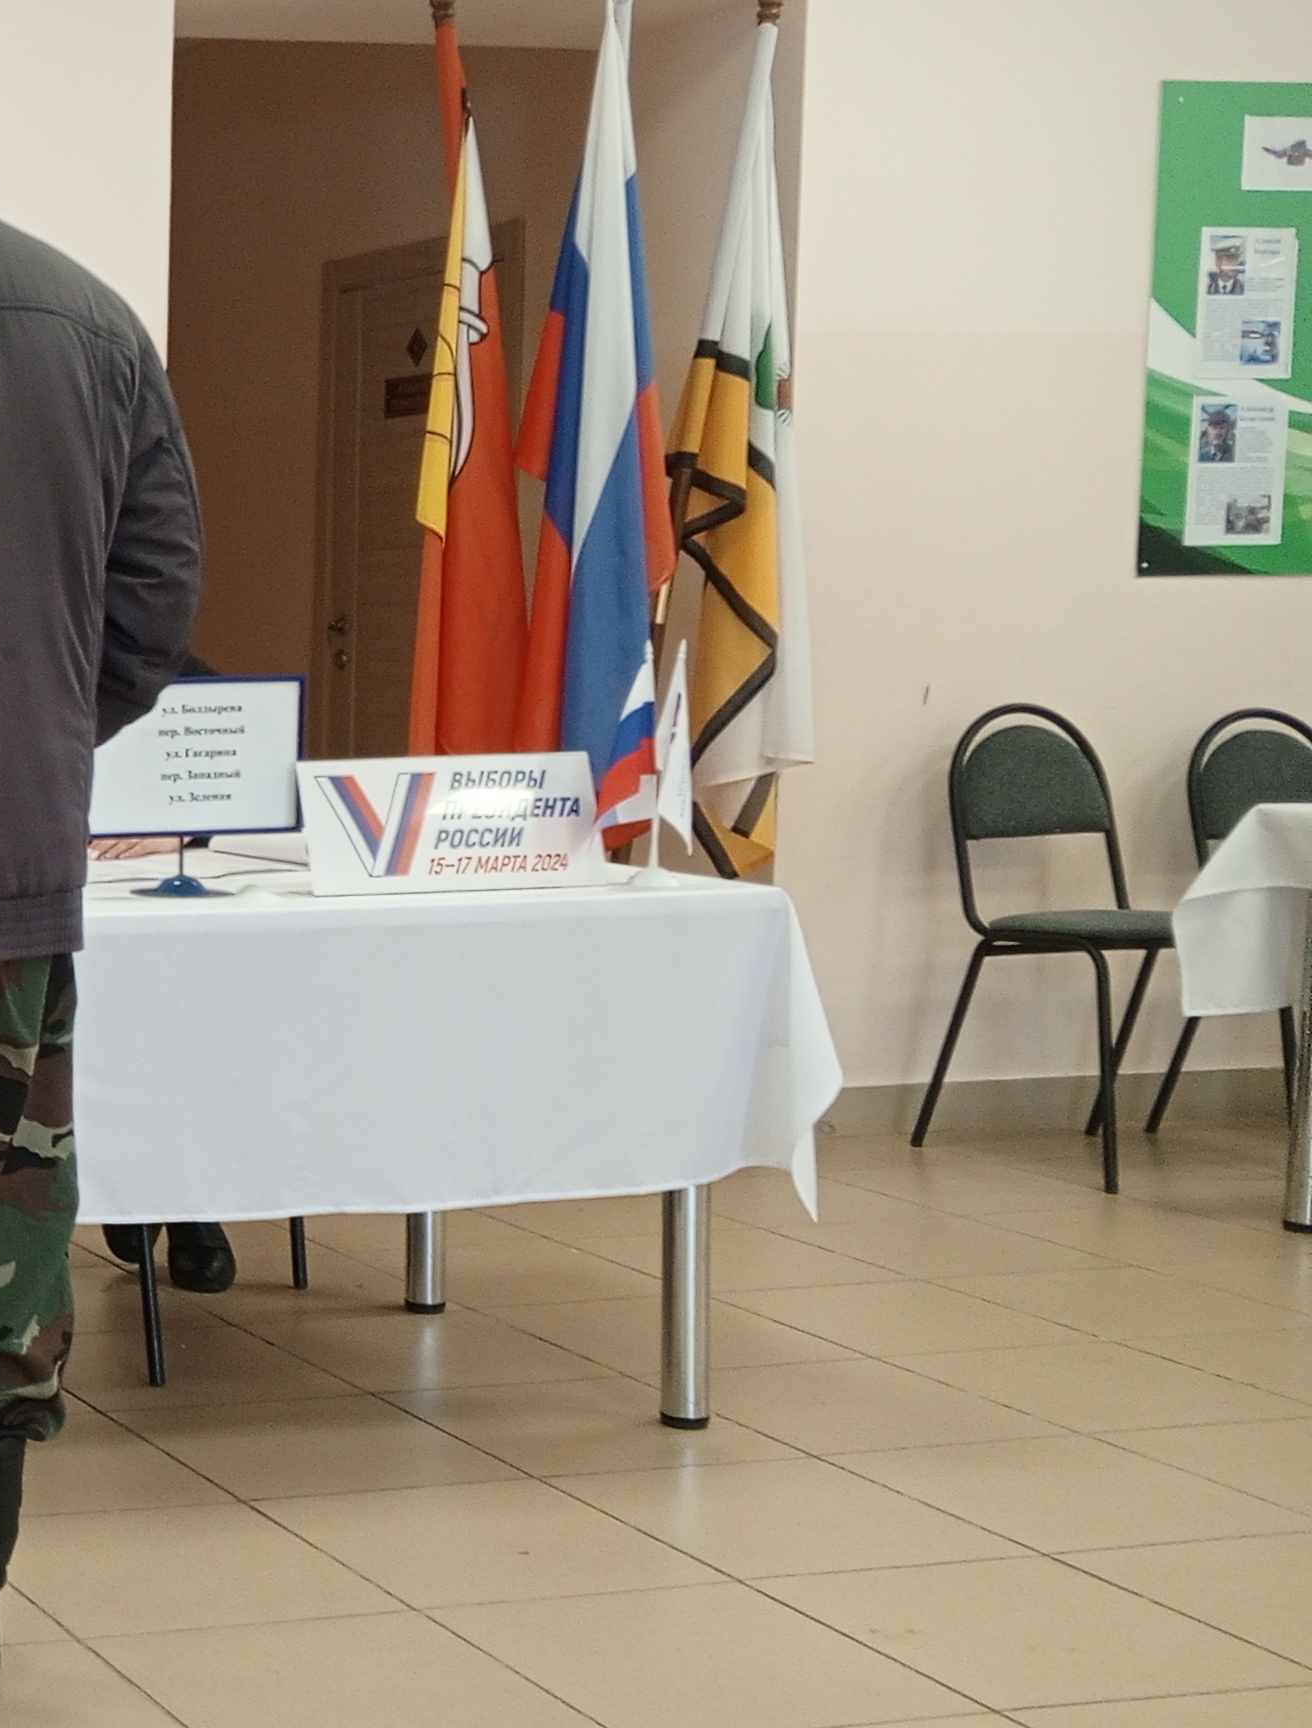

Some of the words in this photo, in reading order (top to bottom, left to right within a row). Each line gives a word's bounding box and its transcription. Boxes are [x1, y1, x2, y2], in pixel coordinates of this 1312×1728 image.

[162, 707, 179, 718] ул.
[158, 729, 181, 739] пер.
[183, 725, 246, 736] Восточный
[165, 750, 182, 761] ул.
[184, 748, 237, 760] Гагарина
[160, 773, 183, 783] пер.
[186, 769, 242, 780] Западный
[450, 769, 547, 791] ВЫБОРЫ
[168, 795, 185, 805] ул.
[433, 826, 526, 851] РОССИИ
[474, 854, 528, 874] МАРТА
[531, 852, 570, 873] 2024
